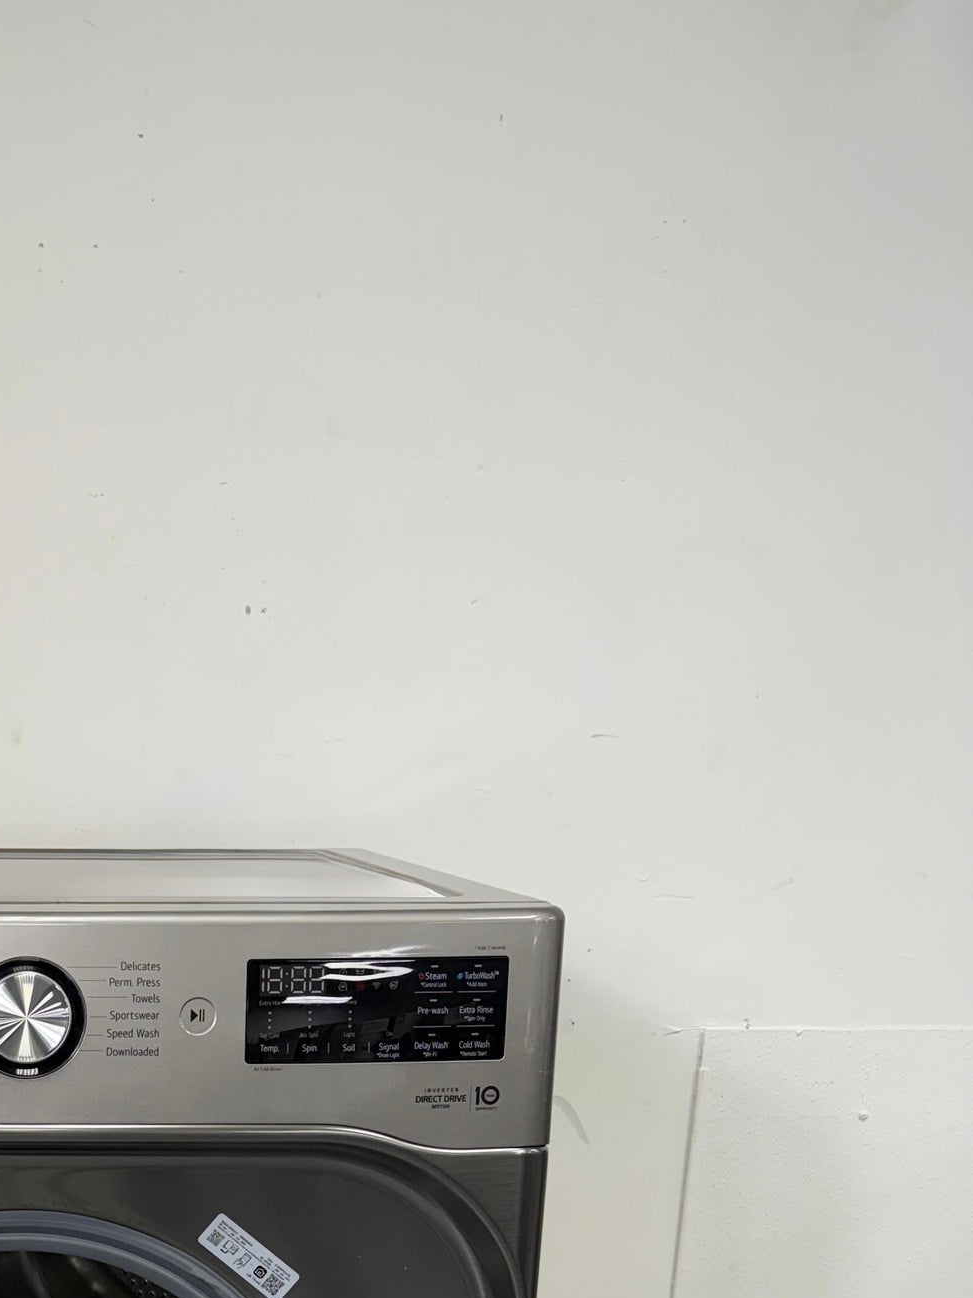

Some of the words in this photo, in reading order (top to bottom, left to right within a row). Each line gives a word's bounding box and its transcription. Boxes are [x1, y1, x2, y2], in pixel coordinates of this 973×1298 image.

[120, 961, 161, 972] Delicates
[425, 971, 448, 981] Steam
[109, 977, 134, 988] Perm.
[136, 977, 161, 988] Press
[131, 994, 161, 1004] Towels
[417, 1006, 449, 1015] Pre-wash
[459, 1006, 476, 1014] Extra
[477, 1005, 494, 1014] Rinse
[109, 1011, 160, 1022] Sportswear
[107, 1029, 134, 1040] Speed
[136, 1029, 160, 1038] Wash
[302, 1044, 317, 1053] Spin
[343, 1044, 355, 1052] Soil
[379, 1043, 399, 1052] Signal
[414, 1042, 431, 1051] Delay
[459, 1041, 473, 1049] Cold
[474, 1041, 490, 1049] Wash
[106, 1047, 160, 1057] Downloaded
[475, 1086, 500, 1106] 10
